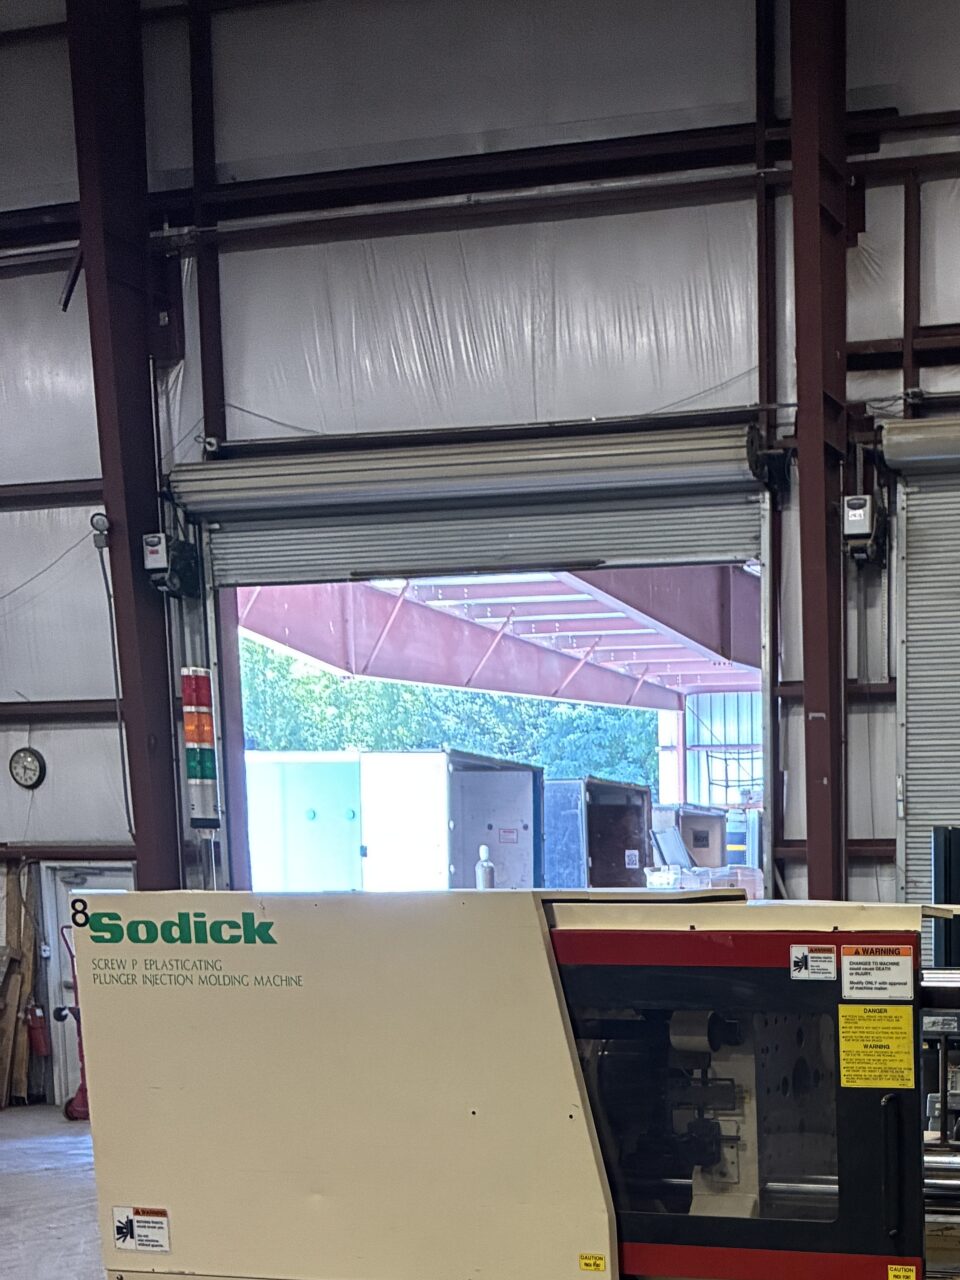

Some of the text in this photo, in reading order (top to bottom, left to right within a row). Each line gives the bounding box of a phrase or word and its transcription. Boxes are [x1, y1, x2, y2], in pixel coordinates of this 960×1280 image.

[71, 898, 89, 927] 8
[88, 911, 278, 944] Sodick
[862, 947, 901, 956] WARNING
[91, 959, 127, 970] SCREW
[92, 973, 303, 987] PLUNGER INJECTION MOLDING MACHINE
